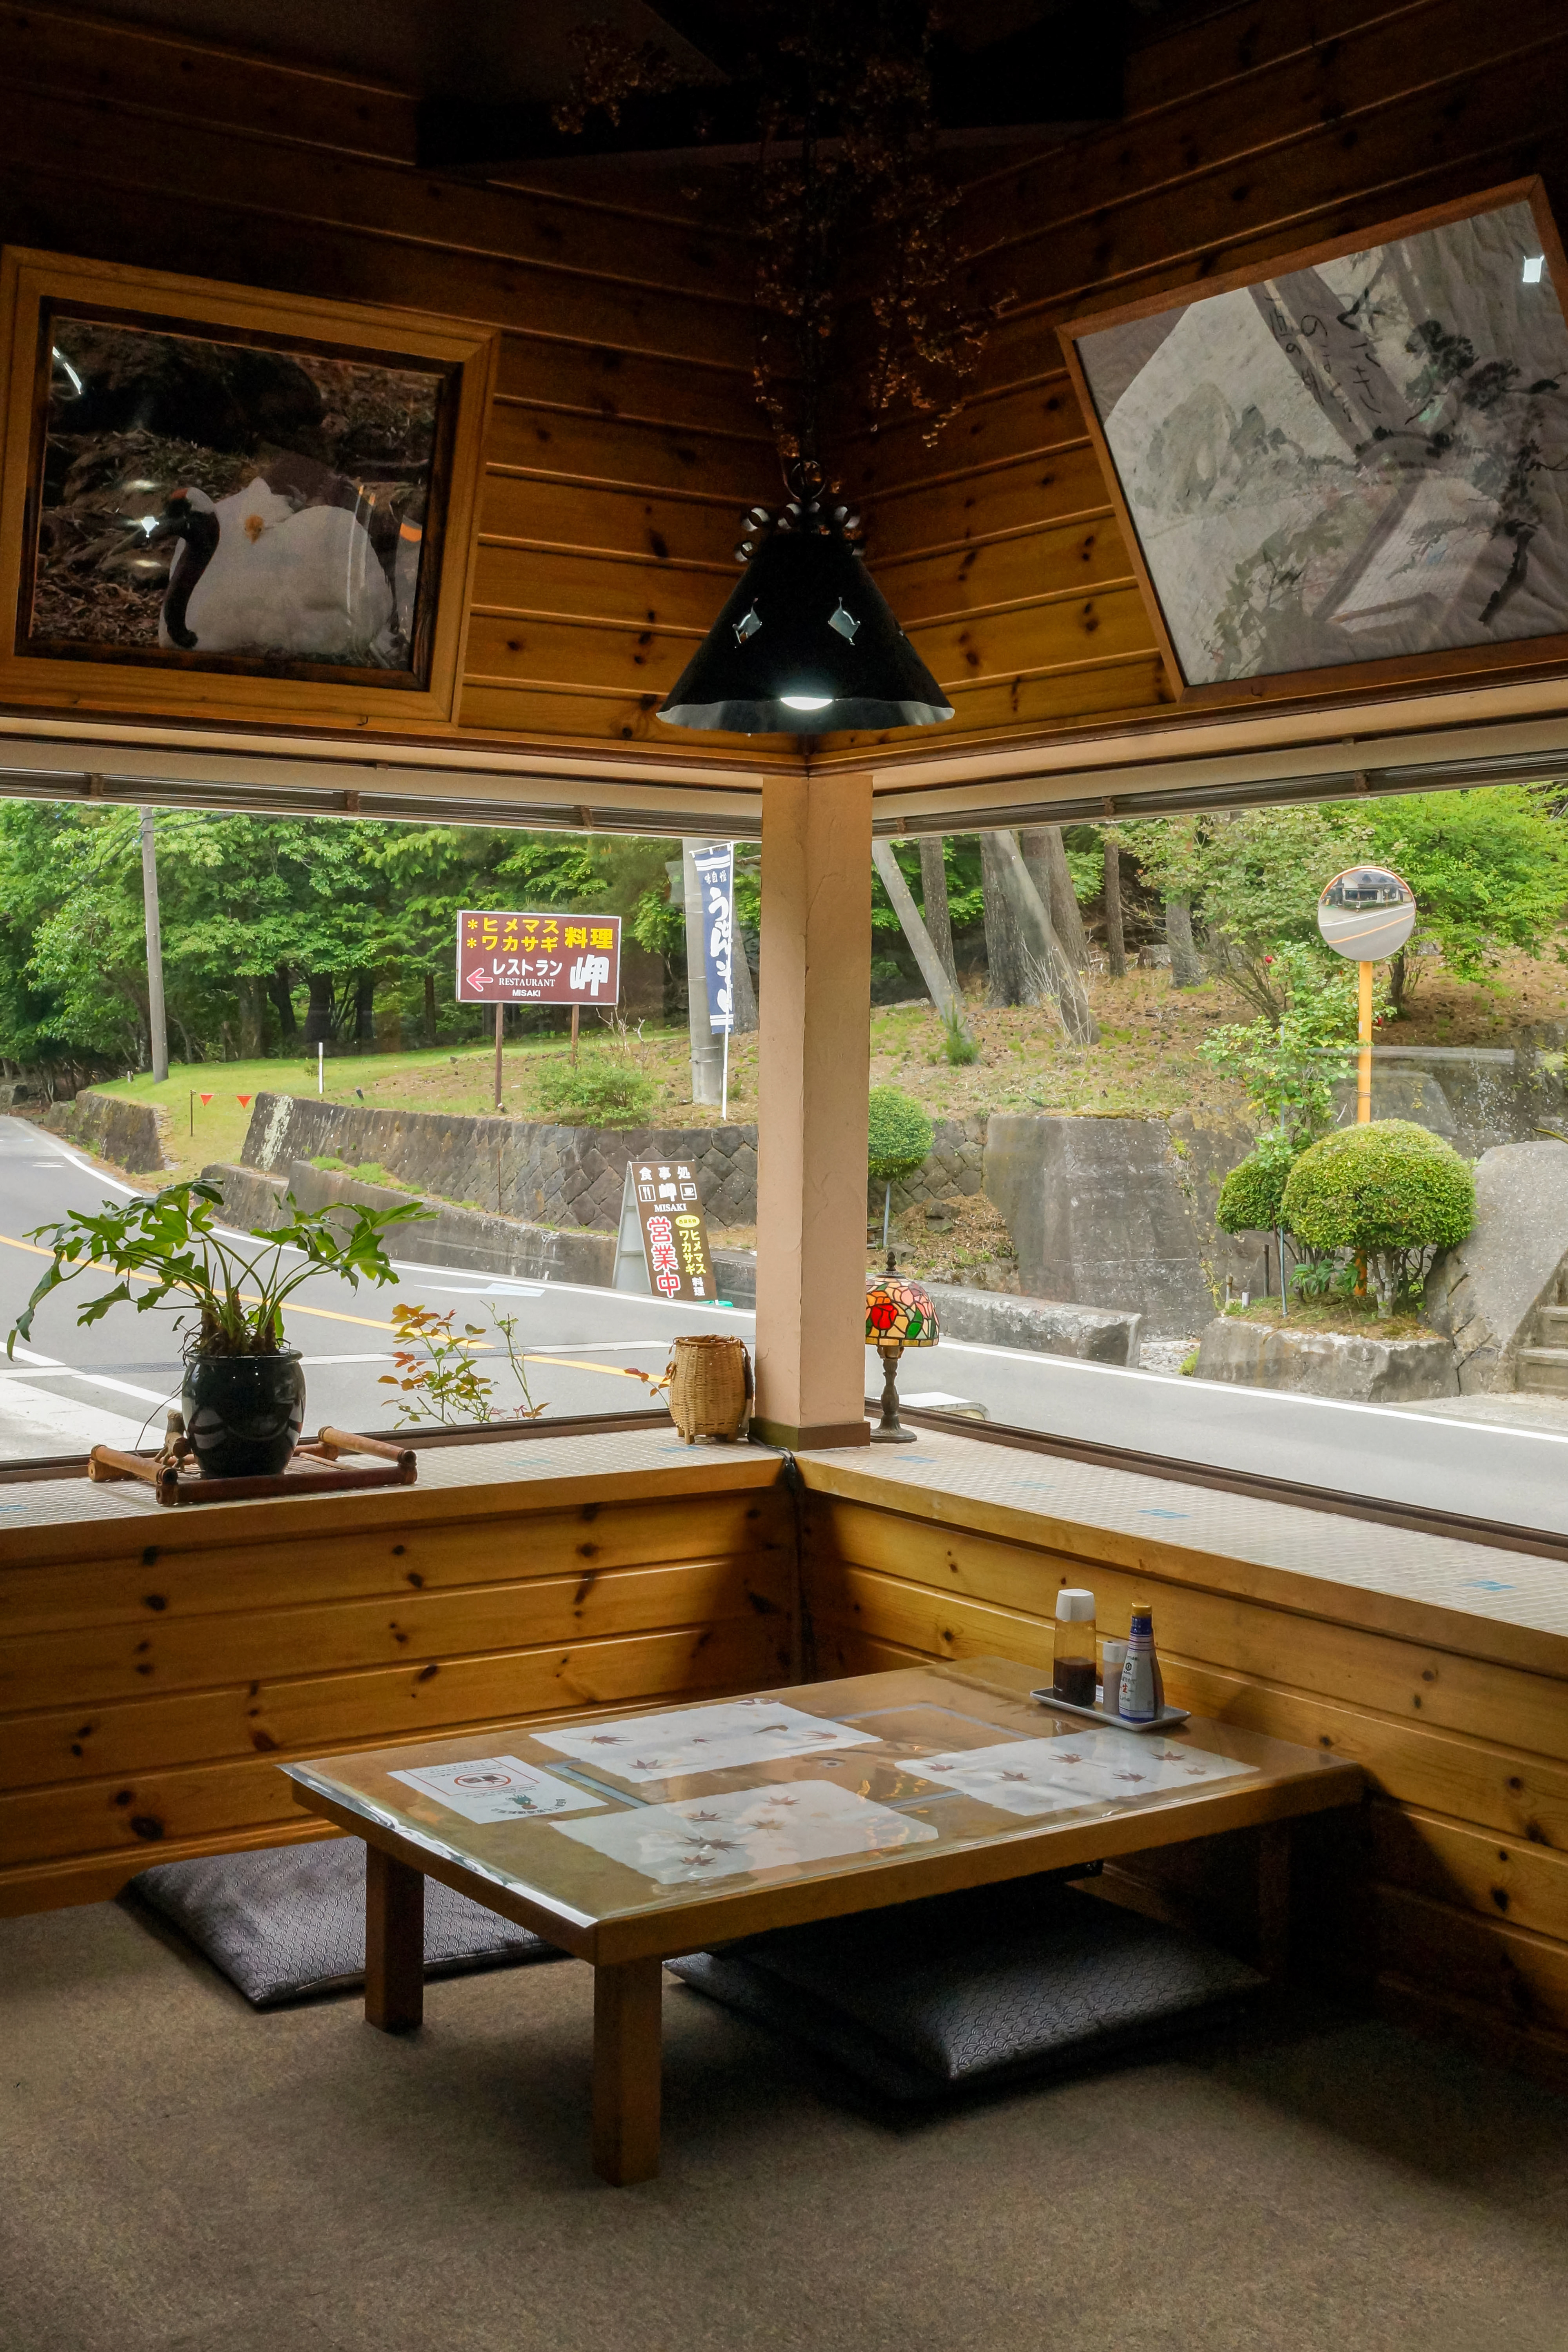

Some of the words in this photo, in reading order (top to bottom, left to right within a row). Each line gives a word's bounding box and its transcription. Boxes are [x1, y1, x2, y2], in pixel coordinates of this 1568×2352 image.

[483, 918, 559, 934] ヒメマス
[565, 927, 613, 949] 料理
[482, 935, 559, 953] ワカサギ
[493, 958, 562, 976] レストラン
[570, 954, 609, 996] 岬
[499, 978, 556, 987] RESTAURANT
[639, 1166, 691, 1180] 食事処
[658, 1183, 677, 1202] 岬
[654, 1203, 687, 1212] MISAKI
[647, 1216, 681, 1298] 営業中
[679, 1230, 696, 1275] ワカサギ
[690, 1229, 706, 1274] ヒメマス
[692, 1277, 705, 1296] 料理
